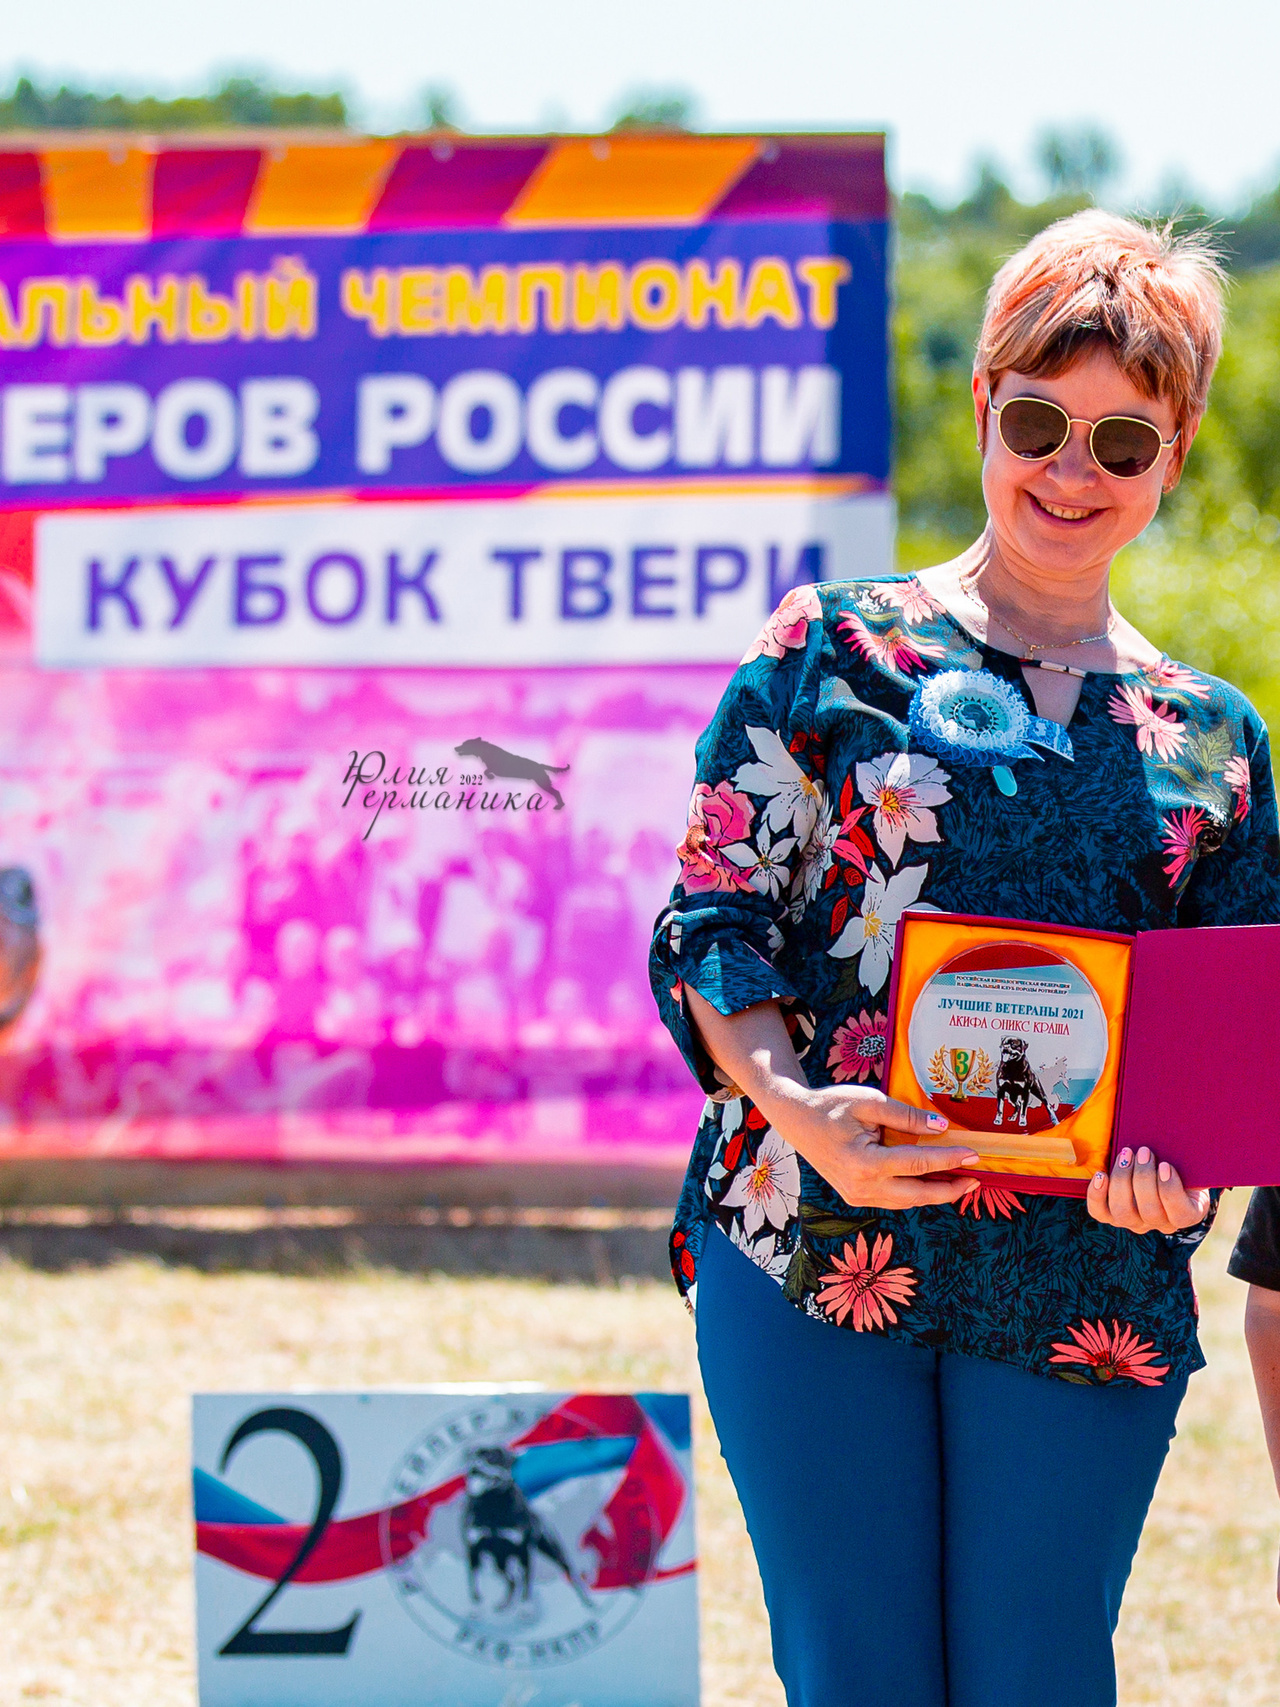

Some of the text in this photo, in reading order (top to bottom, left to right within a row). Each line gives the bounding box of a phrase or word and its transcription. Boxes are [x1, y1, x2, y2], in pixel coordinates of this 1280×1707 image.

[341, 257, 851, 338] ЧЕМПИОНАТ
[3, 365, 841, 485] ЕРОВ РОССИИ
[85, 549, 444, 632] КУБОК
[938, 998, 1084, 1020] ЛУЧШИЕ ВЕТЕРАНЫ 2021
[949, 1014, 1070, 1036] АКИФА ОНИКС КРАША
[955, 1050, 970, 1076] 3
[215, 1408, 362, 1656] 2
